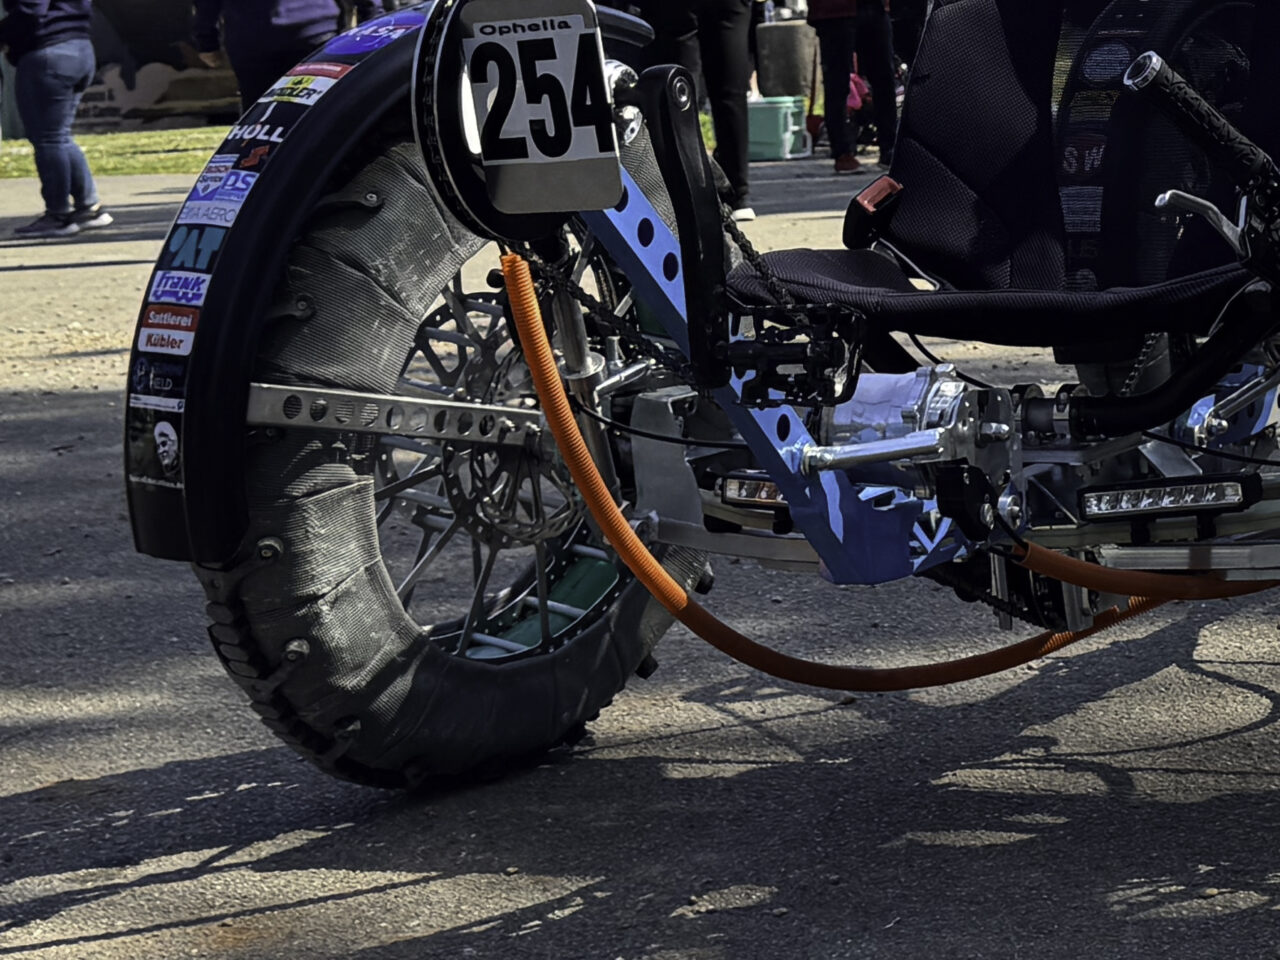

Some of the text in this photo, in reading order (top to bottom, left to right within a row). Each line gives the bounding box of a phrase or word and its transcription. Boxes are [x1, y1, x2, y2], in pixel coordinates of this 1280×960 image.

[470, 32, 616, 162] 254
[228, 124, 284, 142] HOLL
[148, 311, 193, 327] Sattlerei
